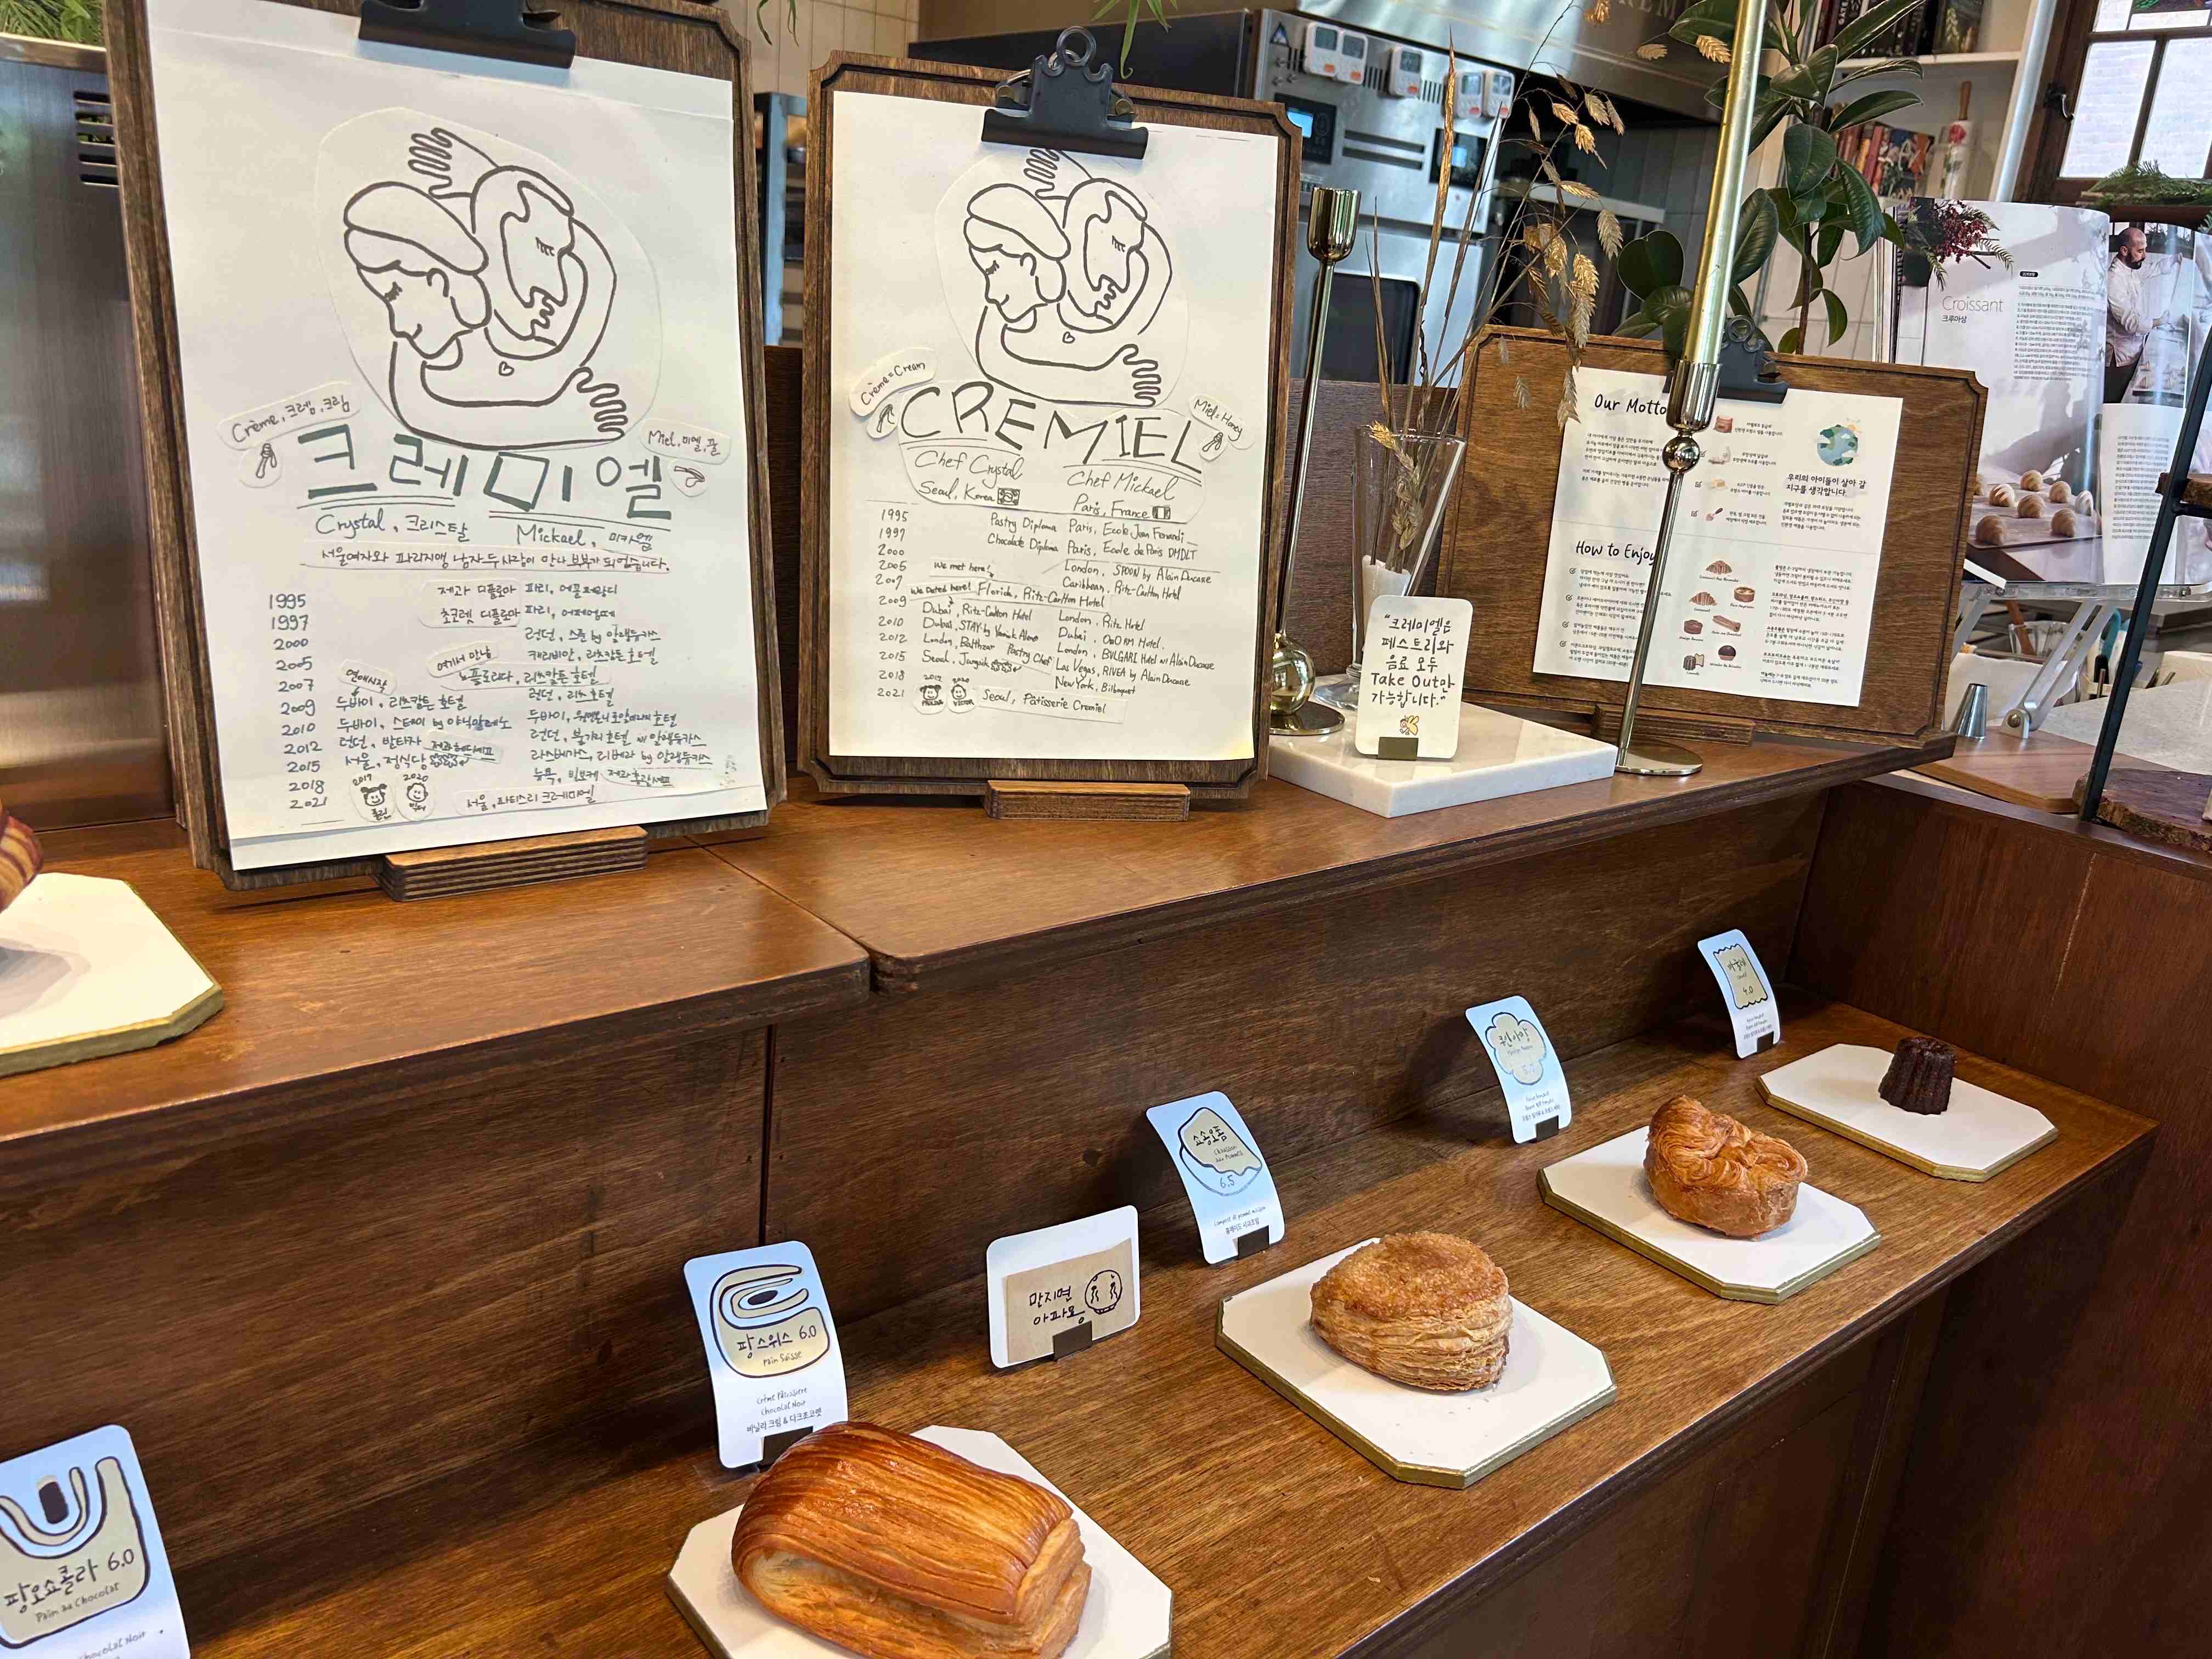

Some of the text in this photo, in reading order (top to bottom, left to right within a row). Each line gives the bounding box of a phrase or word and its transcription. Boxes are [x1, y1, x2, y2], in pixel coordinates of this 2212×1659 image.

[1942, 296, 2004, 313] Croissant
[1594, 393, 1667, 415] Our Motto
[900, 381, 1203, 475] CREMIEL
[297, 424, 671, 520] 크레미엘
[915, 450, 1025, 488] Chef Crystal
[1067, 470, 1179, 500] Chef Mickael
[1786, 484, 1807, 494] 지구를
[1787, 473, 1867, 489] 우리의 아이들이 살아 갈
[964, 483, 996, 501] Korea
[882, 509, 909, 522] 1995
[1111, 500, 1150, 518] France
[405, 515, 470, 543] 크리스탈
[991, 512, 1017, 533] Pastry
[1023, 517, 1057, 533] Diploma
[1103, 522, 1128, 535] Ecole
[1130, 523, 1149, 539] Jean
[610, 532, 652, 551] 미카엘
[879, 528, 906, 541] 1997
[878, 544, 904, 556] 2000
[988, 533, 1025, 548] Chocolate
[1029, 538, 1058, 556] Diploma
[1103, 540, 1130, 555] Ecole
[1135, 543, 1144, 555] de
[1146, 544, 1163, 556] Paris
[1576, 540, 1656, 566] How to Enjoy
[396, 552, 448, 569] 파리지앵
[502, 552, 534, 567] 사람이
[541, 552, 567, 567] 만나
[567, 554, 600, 569] 부부가
[879, 559, 907, 571] 2005
[1113, 564, 1140, 577] SPOON
[1143, 568, 1151, 582] by
[1156, 566, 1178, 582] Alain
[438, 585, 471, 596] 제과
[875, 574, 903, 590] 2007
[950, 582, 972, 591] here!
[878, 595, 907, 607] 2009
[1163, 585, 1182, 600] Hotel
[269, 594, 307, 610] 1995
[1079, 595, 1105, 608] Hotel
[272, 614, 308, 631] 1997
[481, 608, 521, 625] 디플로마
[878, 616, 904, 627] 2010
[1013, 609, 1032, 621] Hotel
[1103, 614, 1146, 631] Ritz Hotel
[273, 638, 308, 650] 2000
[879, 634, 907, 644] 2012
[1382, 636, 1454, 654] 페스트리와
[437, 646, 492, 671] 여기서 만남
[879, 651, 907, 661] 2015
[1007, 643, 1188, 668] Pastry Chef BVLGARI Hotel Alain
[1386, 654, 1438, 673] 음료 모두
[276, 657, 313, 672] 2005
[1056, 658, 1069, 672] Las
[1102, 666, 1126, 678] RIVEA
[1130, 669, 1137, 681] by
[1141, 669, 1161, 682] Alain
[346, 669, 388, 694] 연애시작
[571, 665, 599, 685] 호텔
[879, 670, 905, 681] 2018
[1371, 673, 1455, 693] Take Out만
[278, 678, 314, 692] 2007
[877, 689, 905, 698] 2021
[1055, 676, 1136, 697] New Bilboquet
[280, 700, 315, 716] 2009
[438, 695, 467, 711] 호텔
[1023, 693, 1069, 709] Pâtisserie
[1073, 699, 1107, 714] Cremiel
[393, 716, 444, 731] 스테이 by
[653, 710, 677, 727] 호텔
[281, 723, 315, 737] 2010
[572, 729, 632, 746] 불가리 호텔
[284, 742, 322, 754] 2012
[382, 735, 422, 750] 발타자
[383, 754, 427, 770] 정식당
[641, 751, 652, 764] by
[287, 761, 320, 773] 2015
[289, 780, 325, 793] 2018
[353, 774, 428, 786] 2017 2020
[289, 797, 328, 809] 2021
[497, 785, 596, 805] 파티스리 크레미엘
[1742, 986, 1754, 996] 4.0
[1220, 1175, 1235, 1188] 6.5
[1029, 1286, 1072, 1308] 만지면
[737, 1325, 817, 1359] 팡스위스 6.0
[780, 1350, 803, 1362] Suisse
[792, 1400, 806, 1408] Noir
[747, 1421, 767, 1434] 바닐라
[768, 1417, 781, 1428] 크림
[3, 1549, 135, 1613] 팡오쇼콜라 6.0
[35, 1609, 60, 1623] Pain
[75, 1582, 120, 1606] Chocolat
